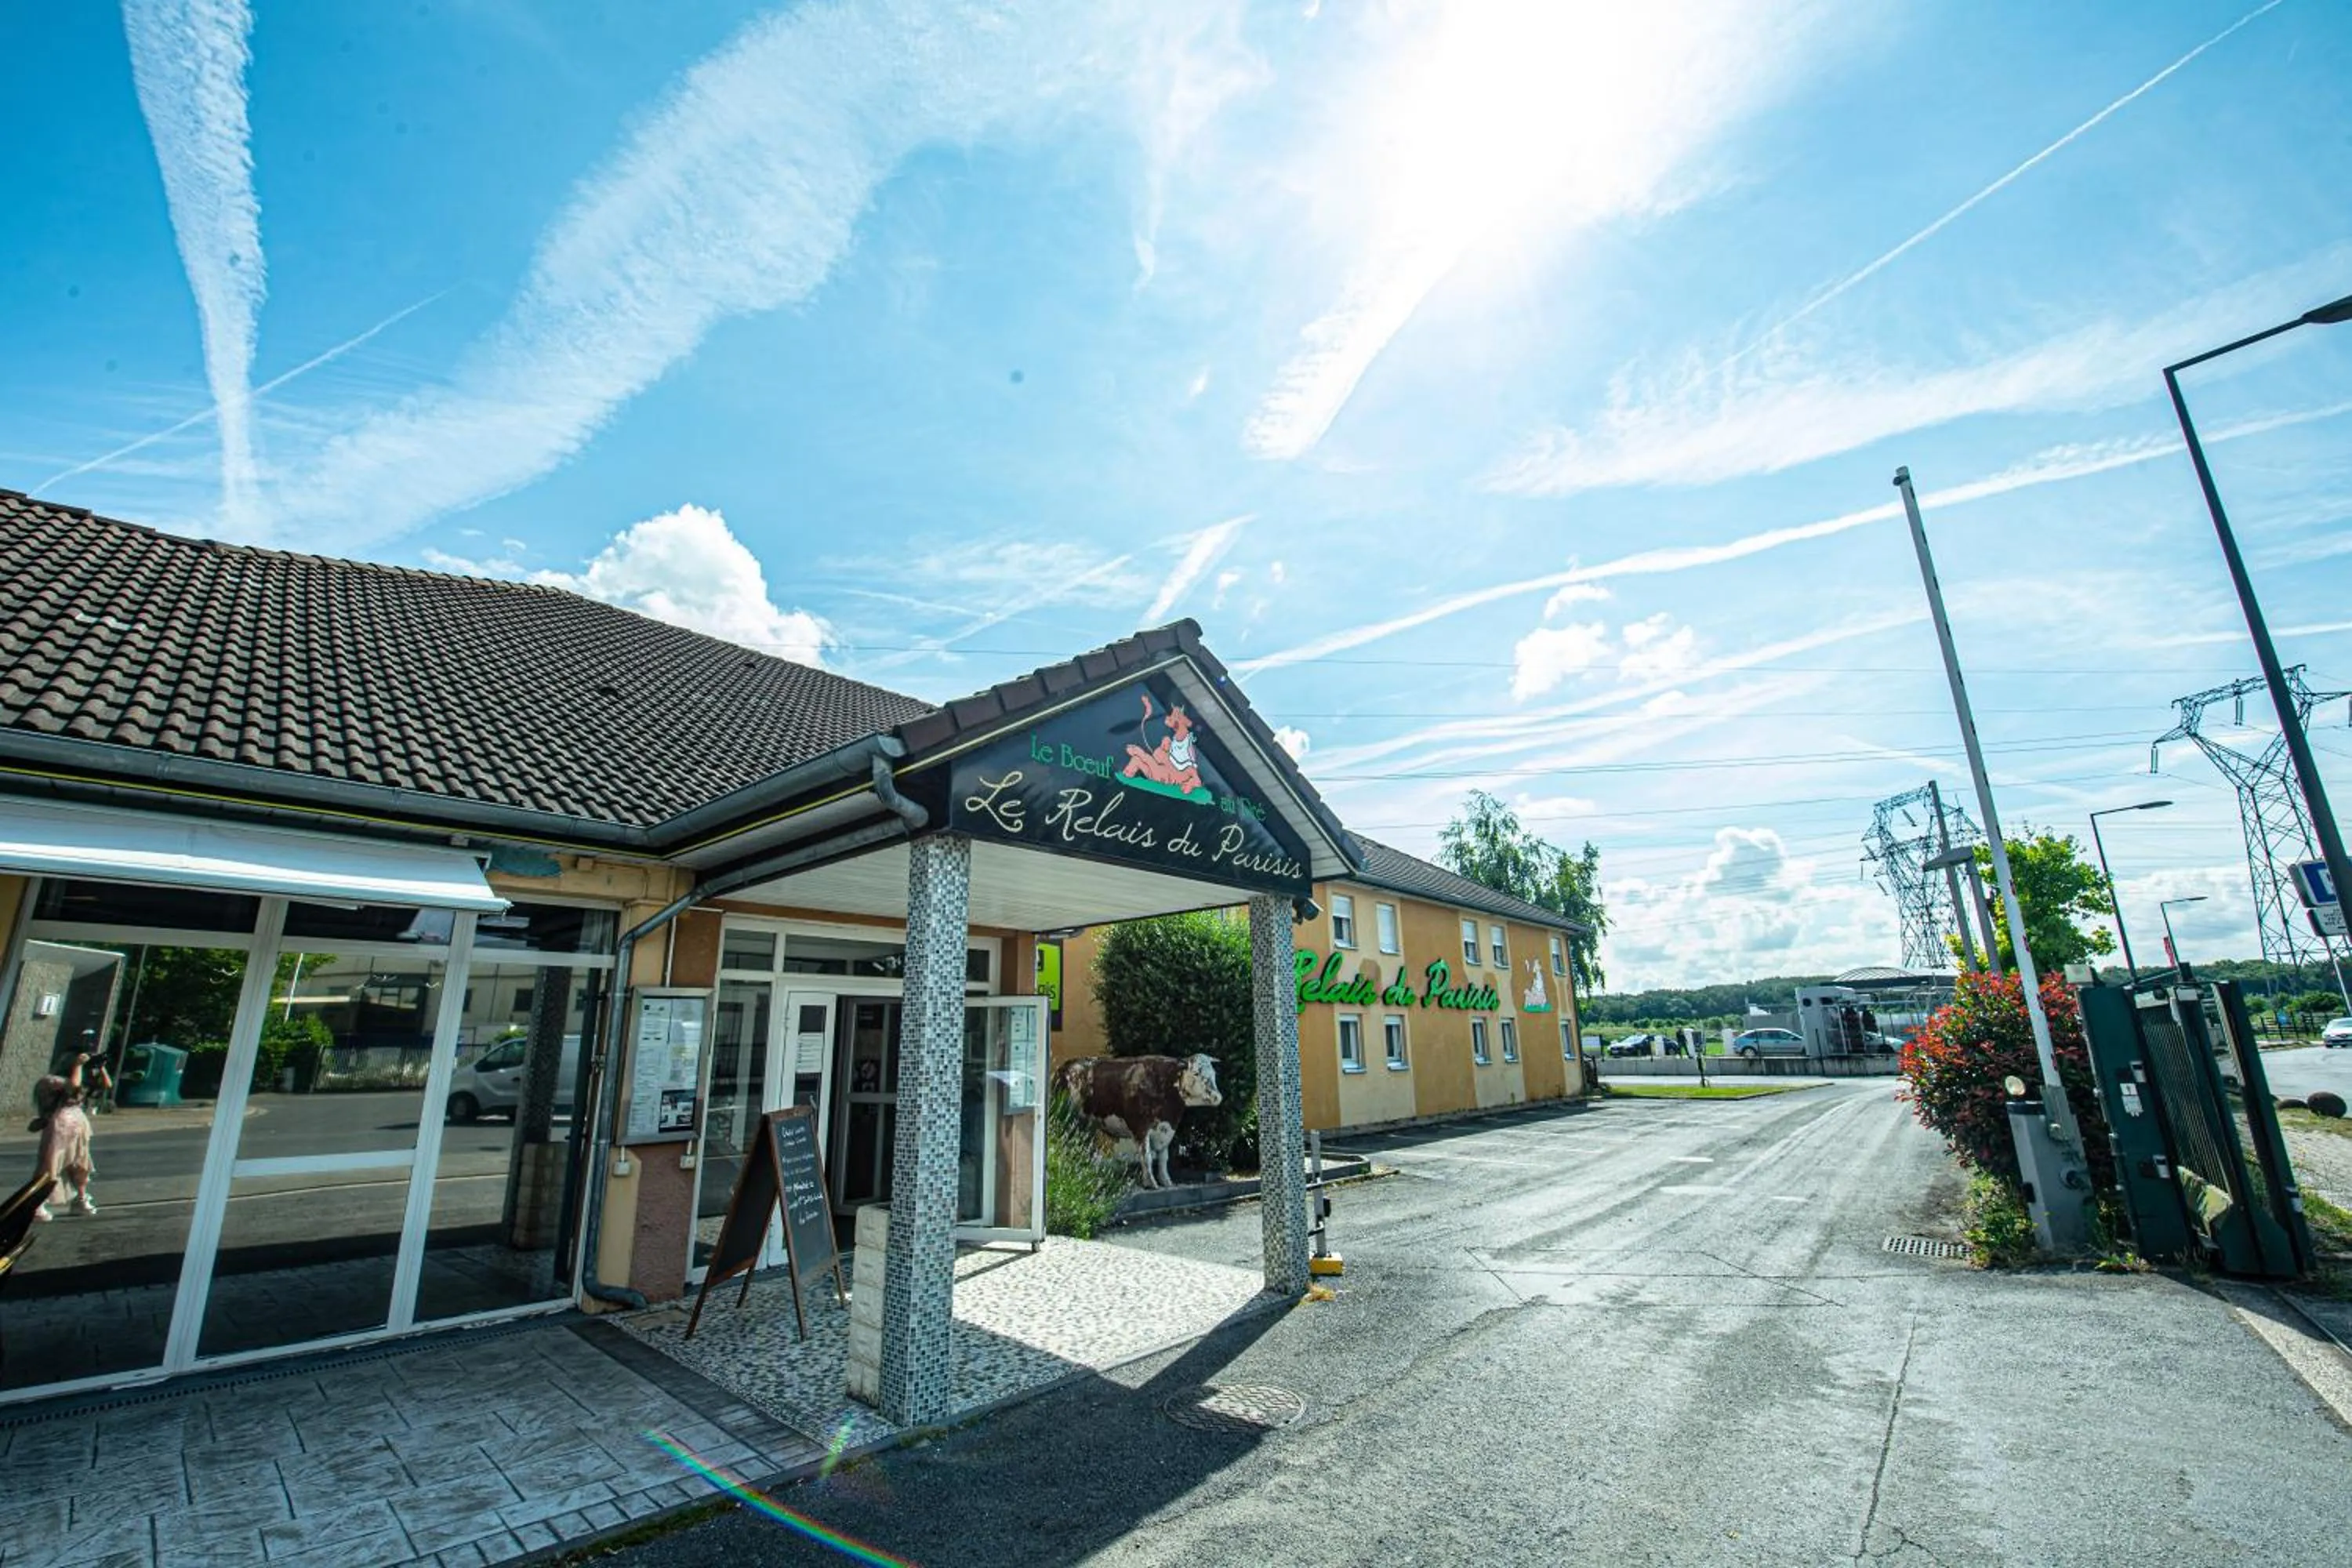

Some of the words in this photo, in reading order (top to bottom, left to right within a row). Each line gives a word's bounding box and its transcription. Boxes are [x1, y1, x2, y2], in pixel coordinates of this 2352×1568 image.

[1030, 731, 1053, 763] Le
[965, 771, 1025, 833] Le
[1045, 788, 1157, 848] Relais
[1167, 822, 1203, 858] du
[1212, 822, 1303, 880] Parisis
[1293, 949, 1377, 1014] Relais
[1382, 965, 1416, 1006] du
[1421, 957, 1501, 1011] Parisis
